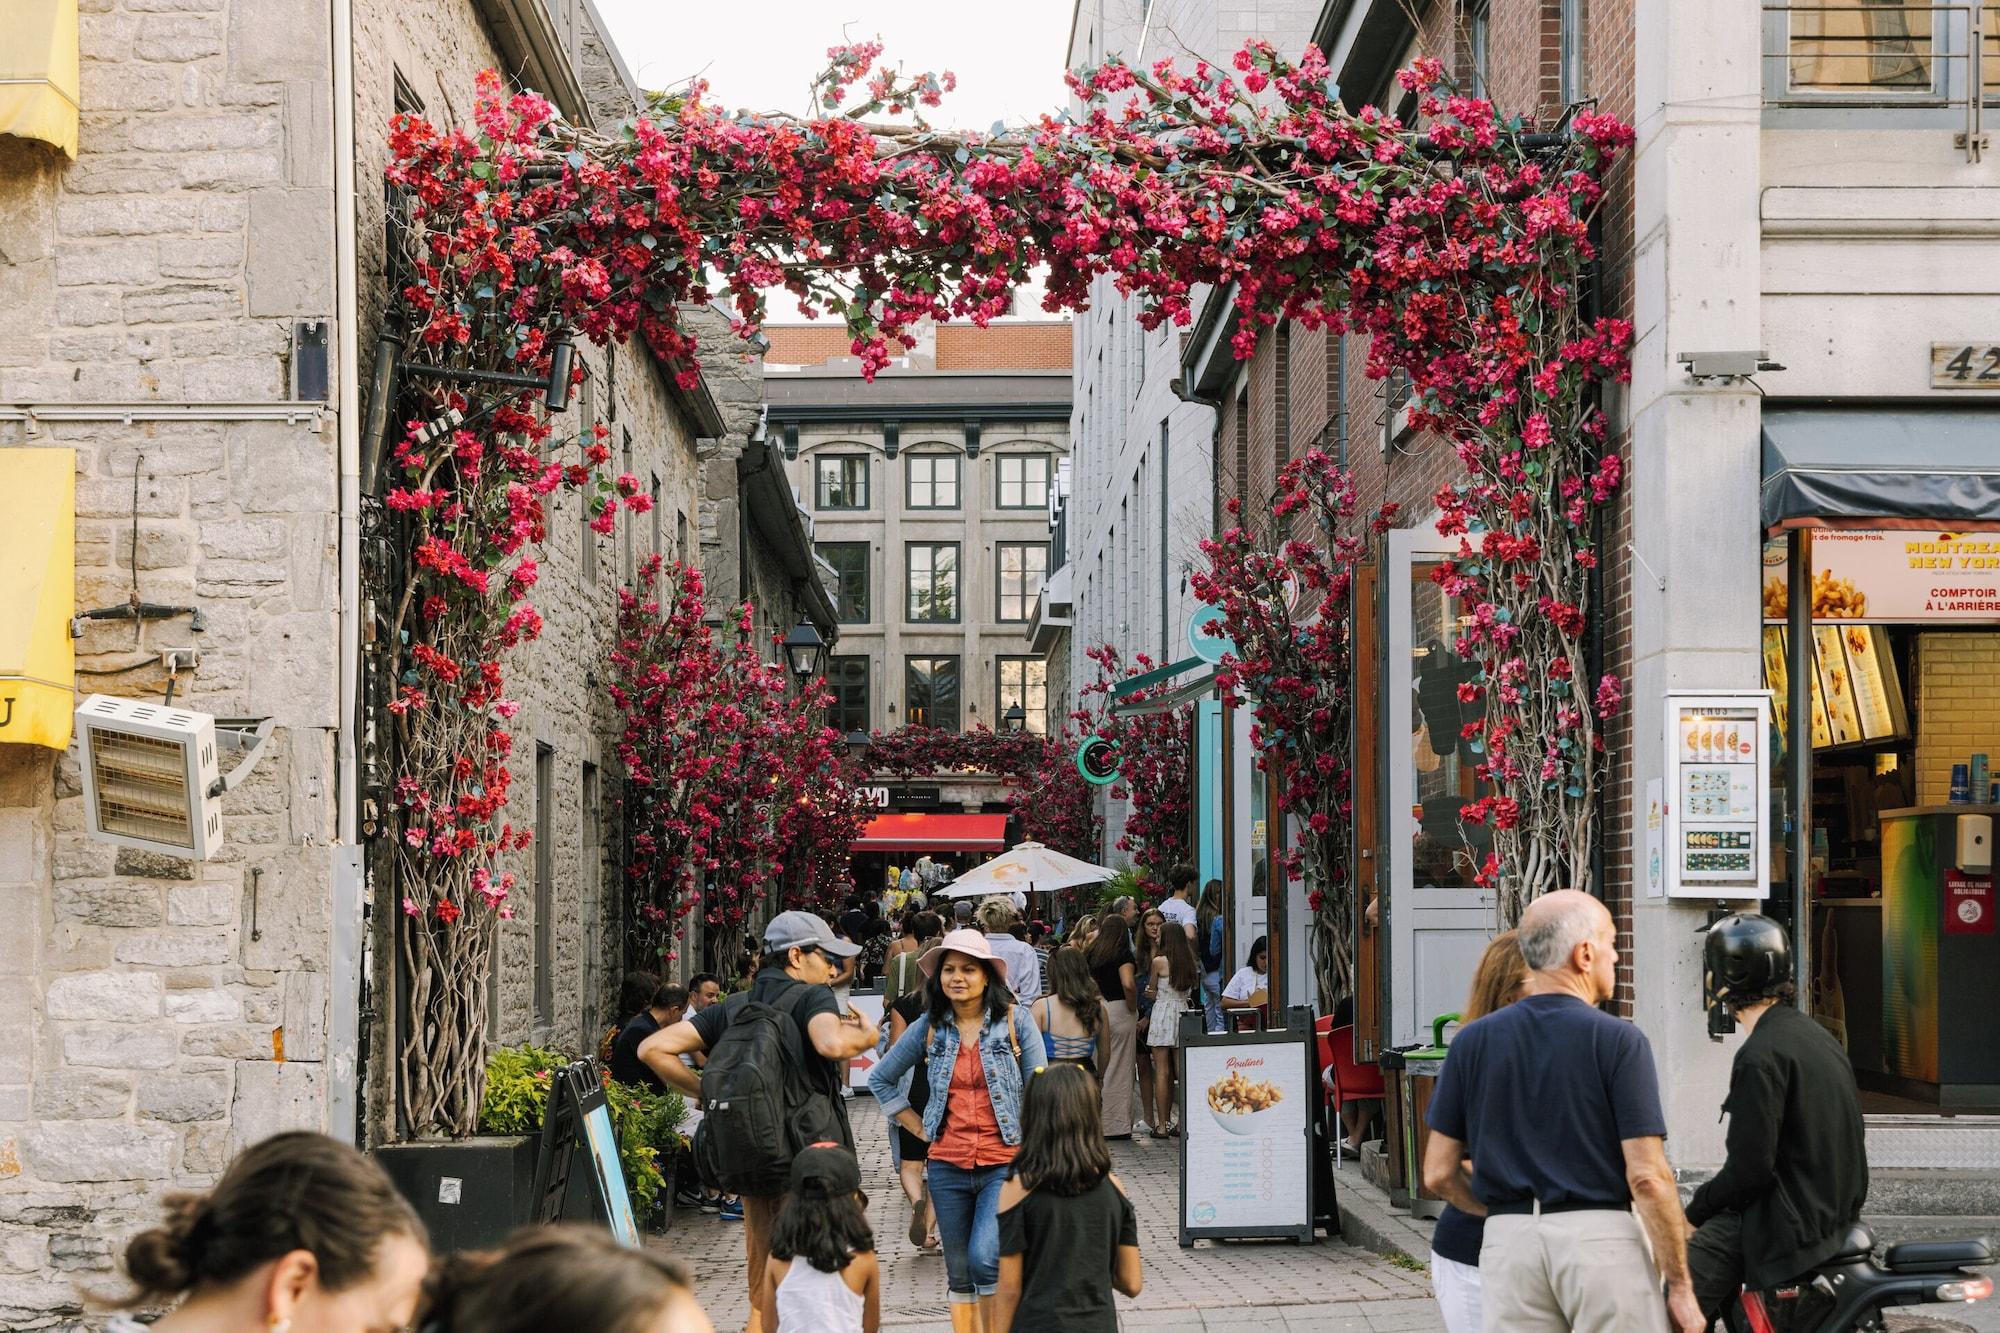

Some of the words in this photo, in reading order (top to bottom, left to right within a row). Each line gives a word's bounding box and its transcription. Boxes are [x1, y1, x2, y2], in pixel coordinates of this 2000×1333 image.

[1945, 346, 2000, 380] 42
[1831, 534, 1864, 542] fromage
[1909, 557, 1952, 569] NEW
[1931, 588, 1997, 598] COMPTOIR
[1925, 599, 1933, 611] À
[1938, 599, 2000, 611] L'ARRIÈRE
[1226, 1056, 1264, 1070] Poutines
